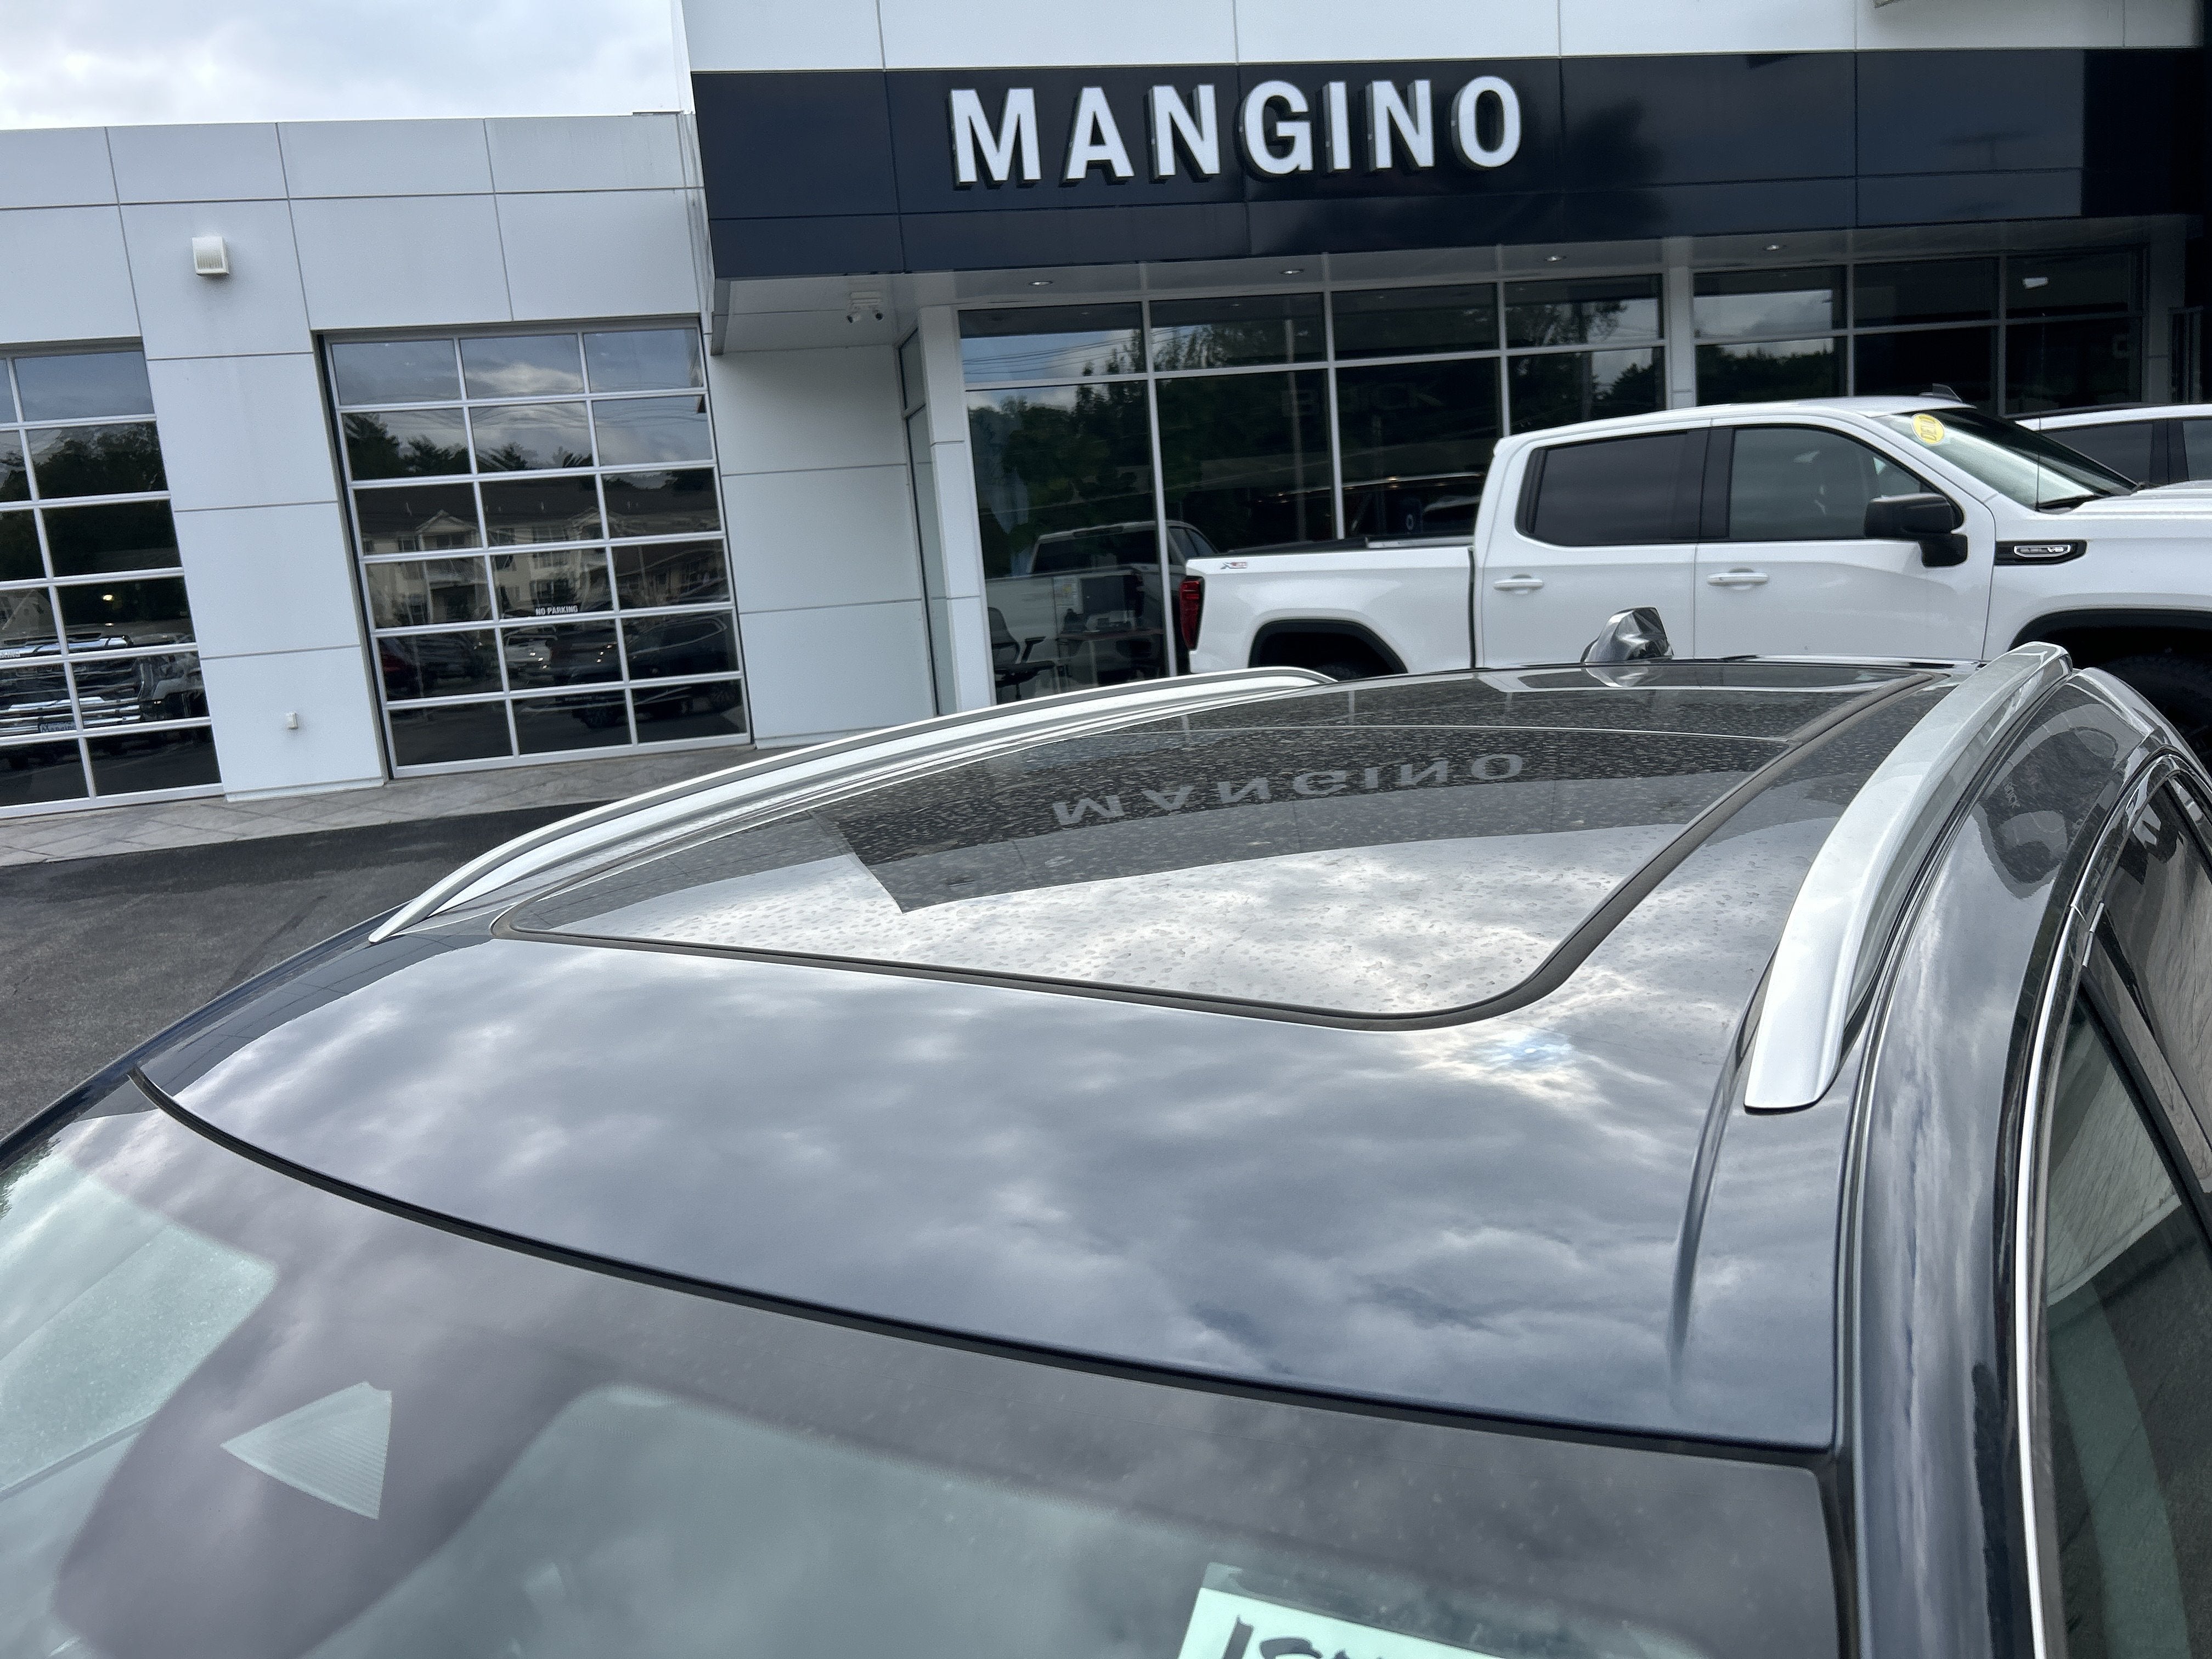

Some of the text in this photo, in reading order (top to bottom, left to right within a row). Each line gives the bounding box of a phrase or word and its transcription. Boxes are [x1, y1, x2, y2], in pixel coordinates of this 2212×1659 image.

[950, 75, 1521, 185] MANGINO
[535, 605, 578, 616] NO PARKING
